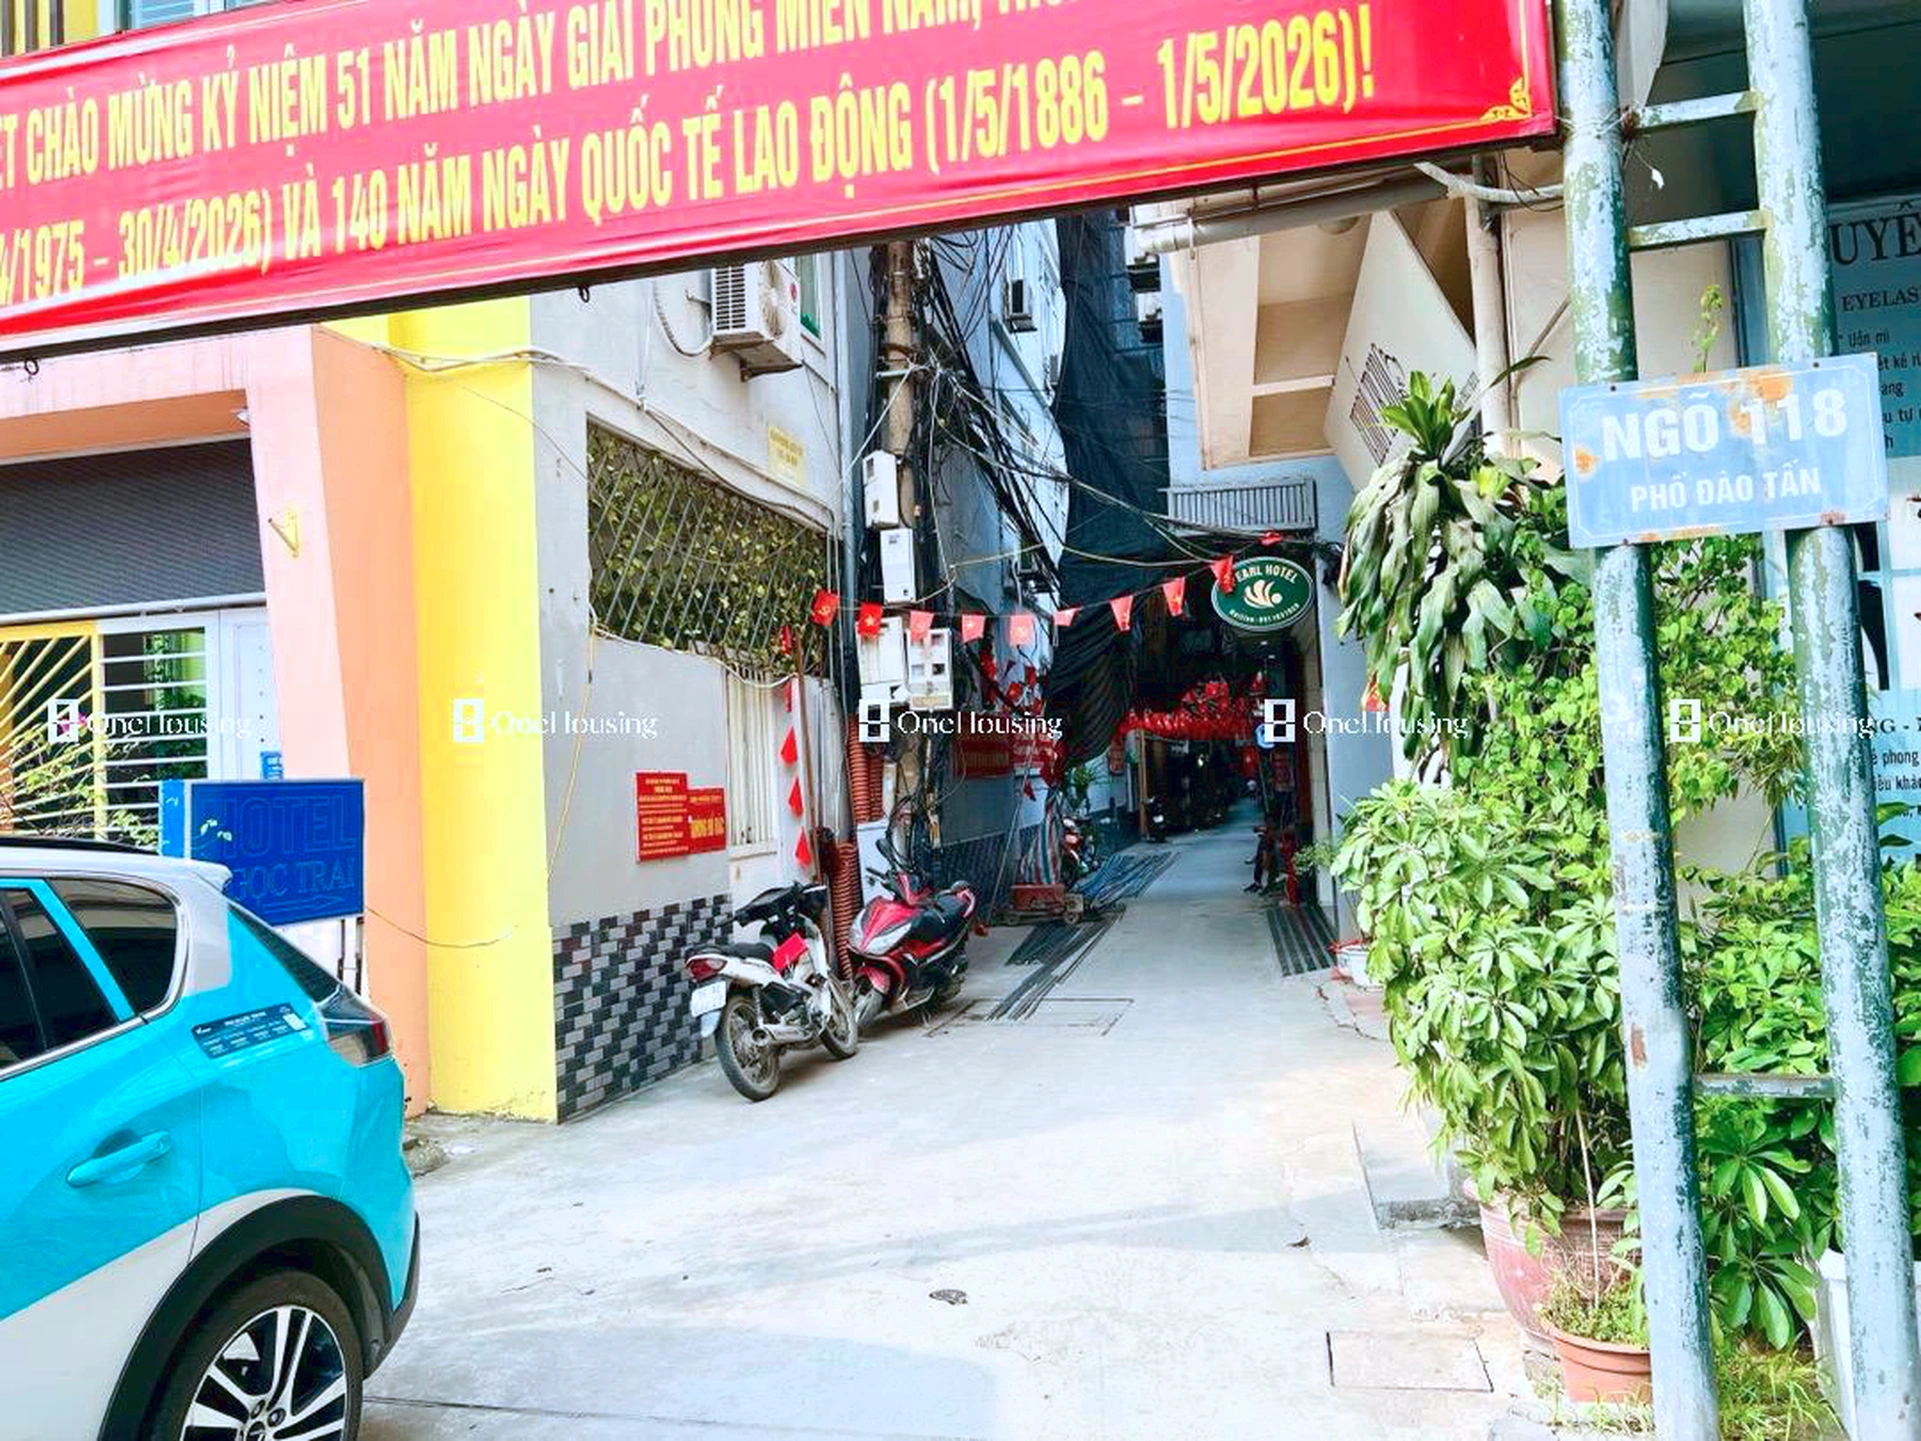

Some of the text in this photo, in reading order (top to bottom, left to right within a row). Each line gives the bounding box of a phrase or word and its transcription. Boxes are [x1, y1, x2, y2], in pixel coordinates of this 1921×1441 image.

[27, 86, 99, 185] CHÀO
[108, 71, 194, 171] MỪNG
[249, 44, 327, 158] NIỆM
[337, 47, 370, 130] 51
[383, 18, 458, 121] NĂM
[468, 0, 556, 107] NGÀY
[119, 188, 272, 276] 30/4/2026)
[282, 163, 322, 260] VÀ
[332, 169, 388, 253] 140
[398, 142, 472, 245] NĂM
[483, 124, 570, 232] NGÀY
[581, 93, 673, 227] QUỐC
[682, 84, 724, 200] TẾ
[733, 101, 799, 194] LAO
[810, 72, 913, 199] ĐỘNG
[925, 50, 1109, 176] (1/5/1886
[1157, 3, 1374, 130] 1/5/2026)!
[1602, 388, 1848, 462] NGÕ 118
[1630, 458, 1823, 513] PHỐ ĐÀO TẤN
[1234, 564, 1299, 584] EARL HOTEL
